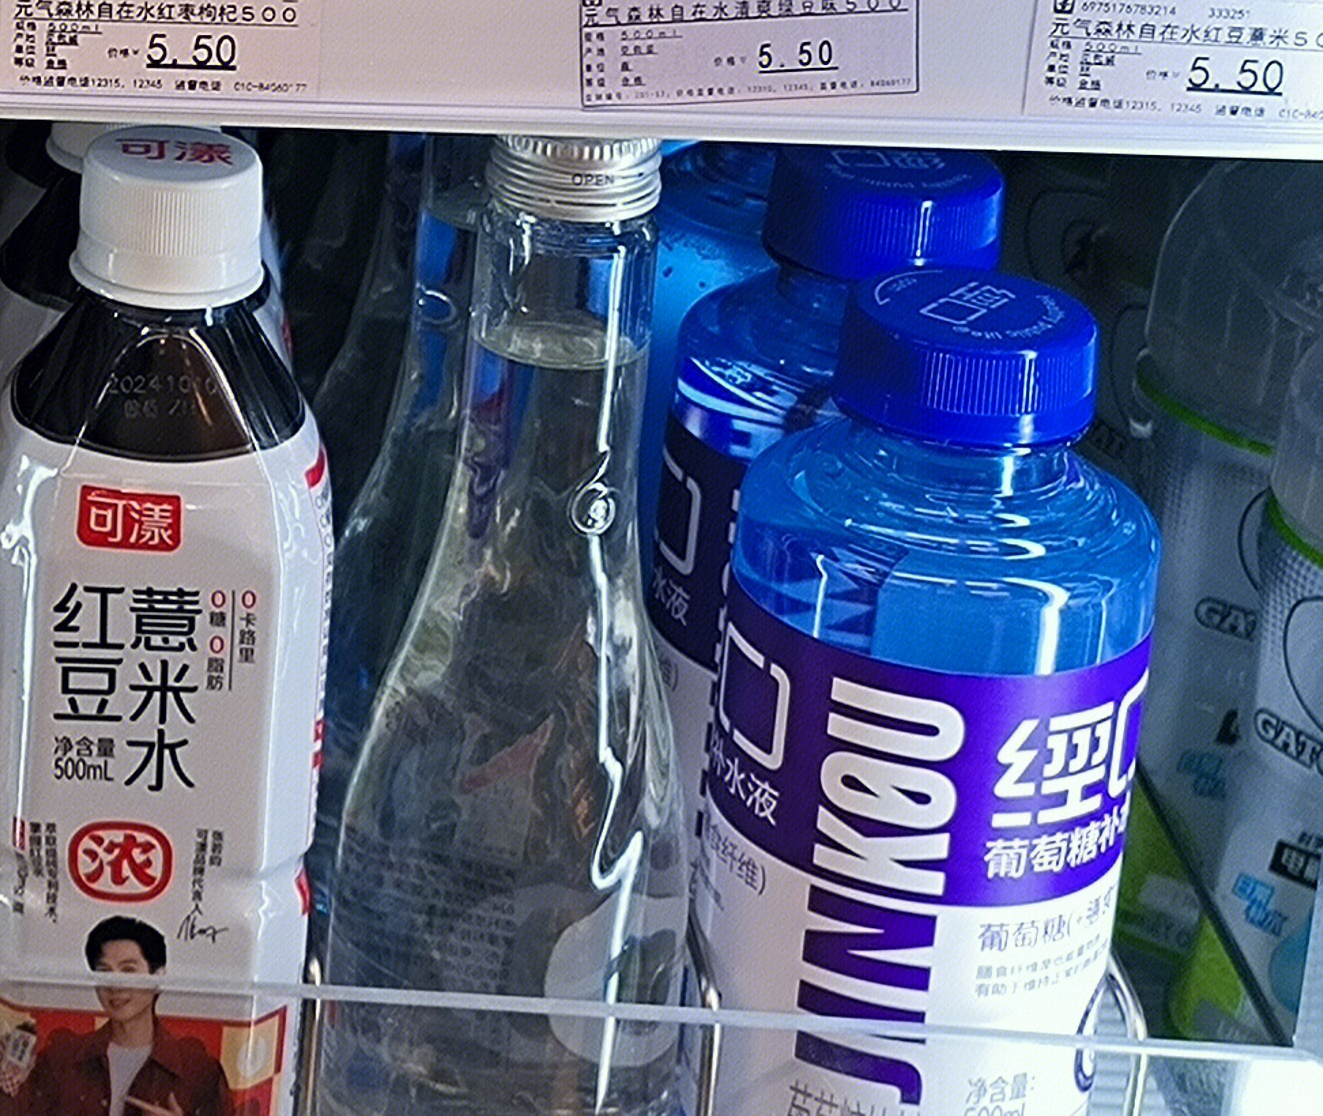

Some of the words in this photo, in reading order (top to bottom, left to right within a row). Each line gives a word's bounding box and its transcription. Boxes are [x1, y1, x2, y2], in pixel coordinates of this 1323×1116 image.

[14, 0, 297, 23] 元气森林自在水红枣枸杞500
[146, 34, 237, 67] 5.50
[758, 39, 834, 70] 5.50
[1187, 56, 1284, 92] 5.50
[114, 138, 234, 167] 可漾
[571, 172, 615, 187] OPEN
[86, 498, 174, 547] 可漾
[208, 589, 228, 629] 0糖
[239, 589, 258, 665] 0卡路里
[52, 582, 126, 722] 红豆
[206, 634, 227, 691] 0脂肪
[123, 585, 204, 793] 薏米水
[53, 736, 116, 758] 净含量
[53, 758, 115, 783] 500mL
[82, 832, 157, 886] 浓
